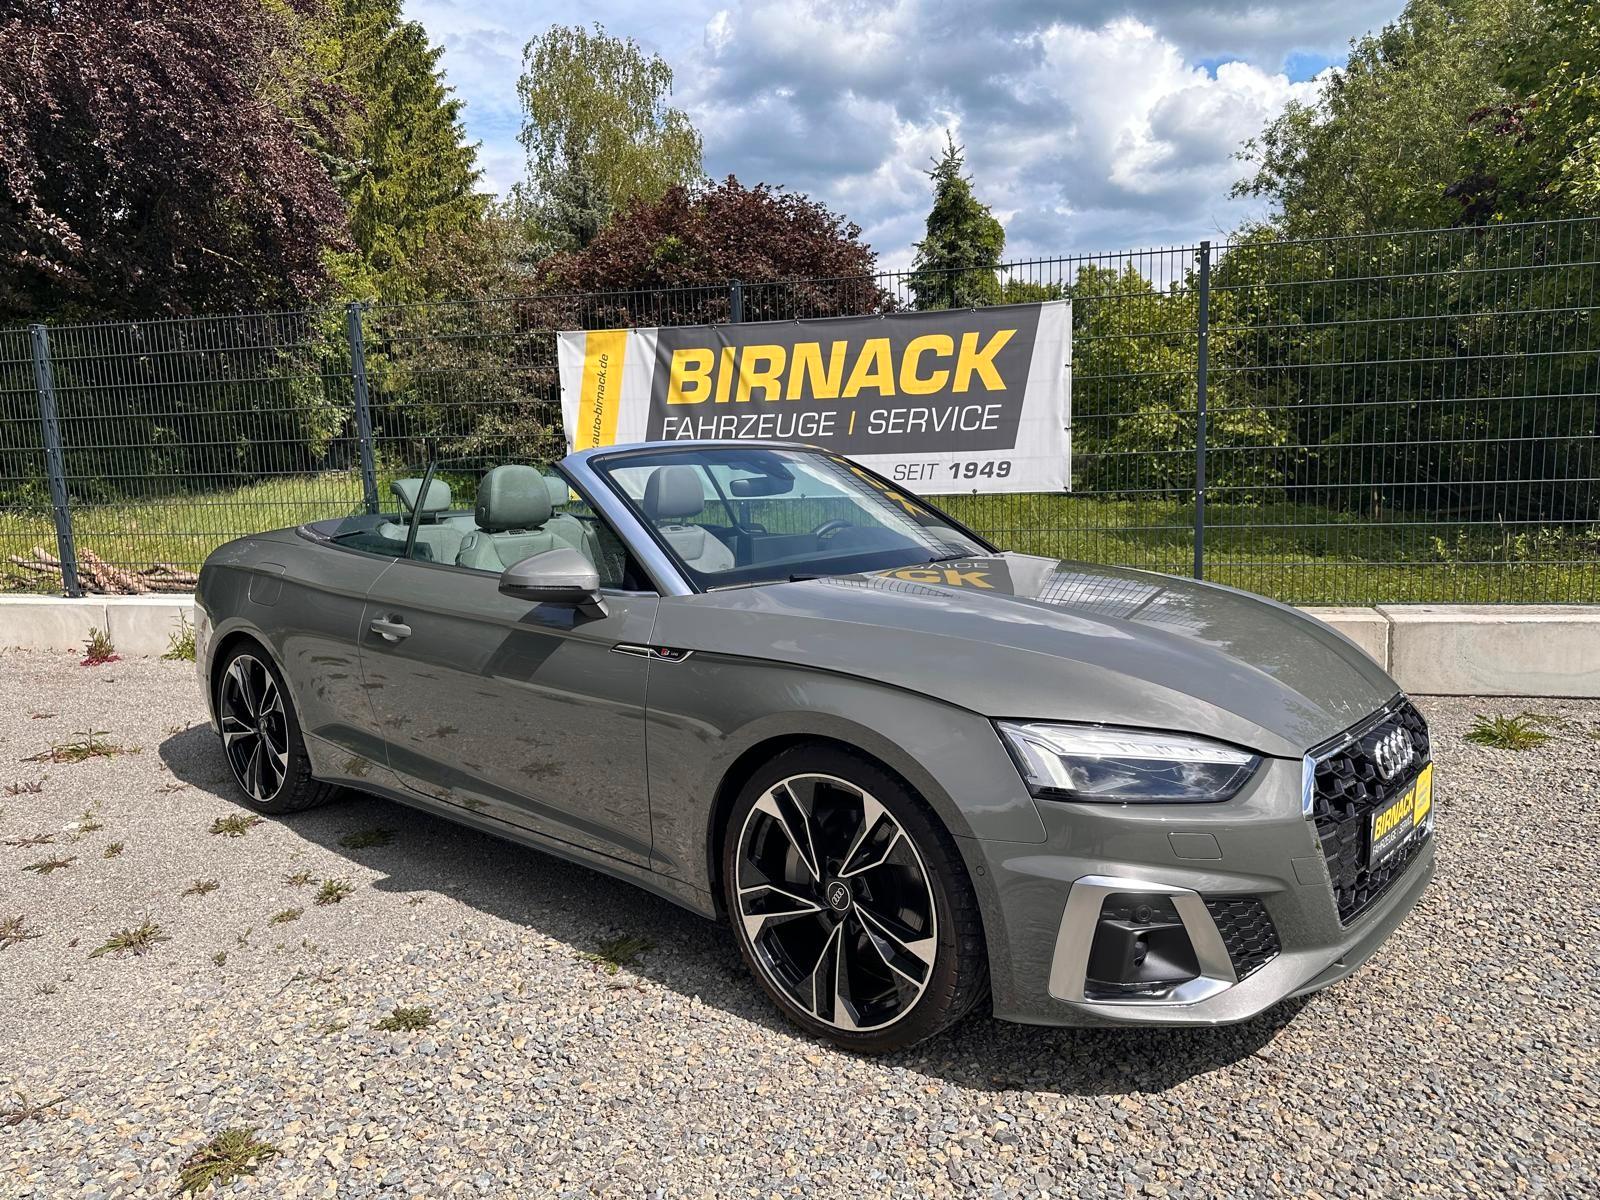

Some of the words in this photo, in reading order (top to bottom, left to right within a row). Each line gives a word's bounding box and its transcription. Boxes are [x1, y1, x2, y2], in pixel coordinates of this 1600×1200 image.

[666, 329, 1017, 405] BIRNACK
[592, 353, 609, 448] .auto-birnack.de
[662, 411, 837, 440] FAHRZEUGE
[867, 404, 1002, 434] SERVICE
[893, 463, 940, 481] SEIT
[949, 460, 1012, 479] 1949
[1374, 787, 1415, 842] BIRNACK
